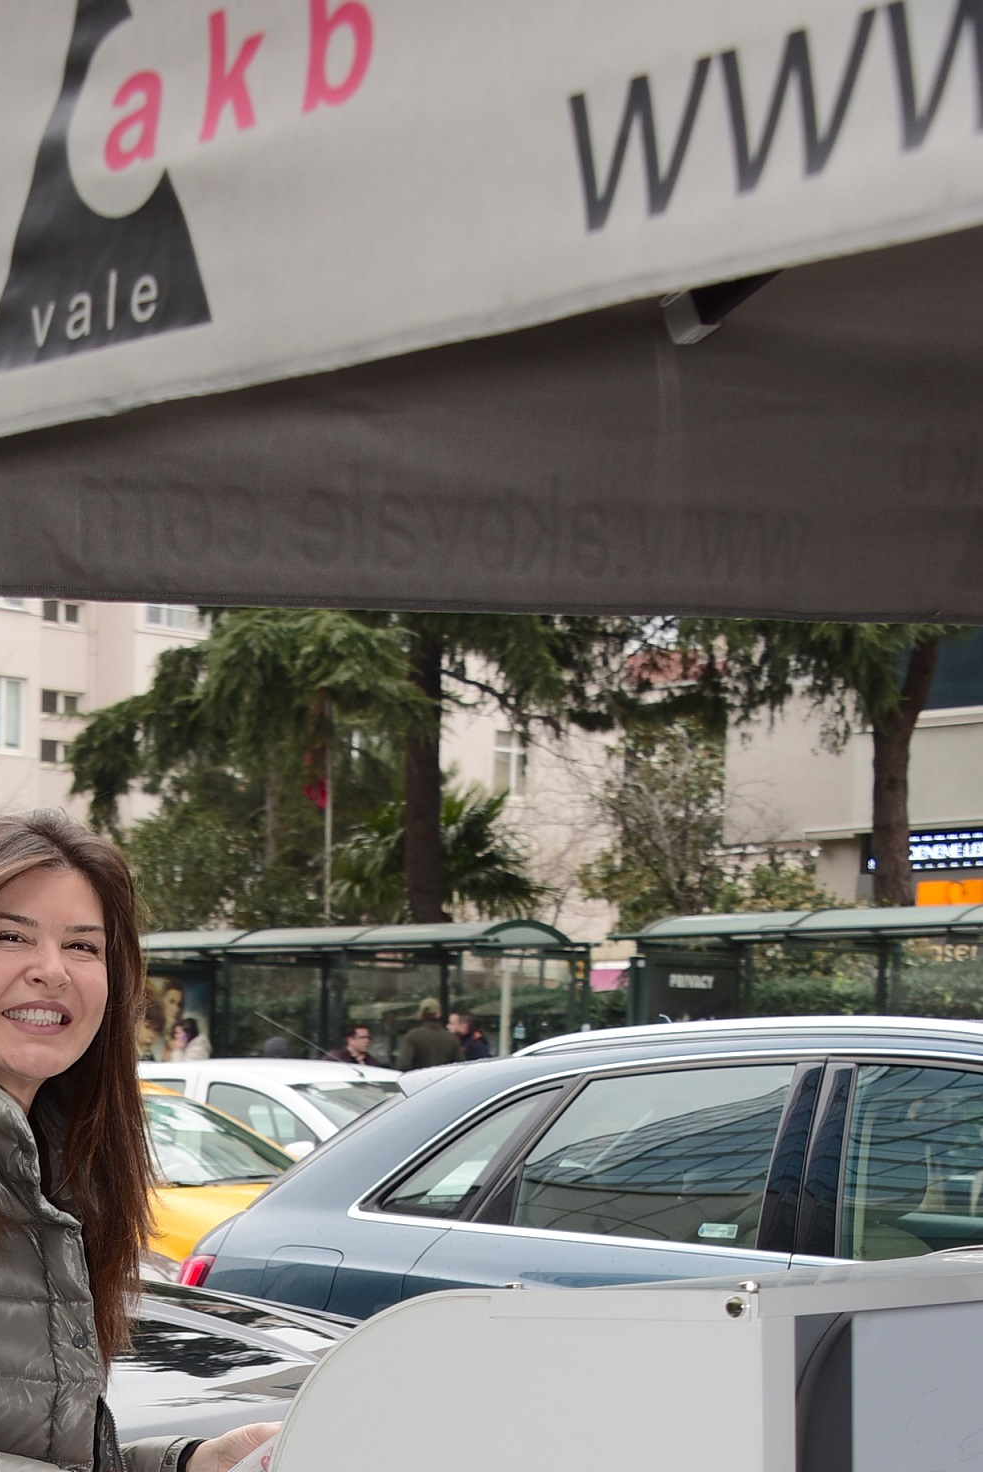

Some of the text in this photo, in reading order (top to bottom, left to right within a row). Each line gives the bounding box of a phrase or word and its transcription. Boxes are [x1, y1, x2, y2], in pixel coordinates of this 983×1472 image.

[103, 0, 375, 172] akb
[31, 268, 160, 348] vale
[669, 973, 715, 990] PRIVACY
